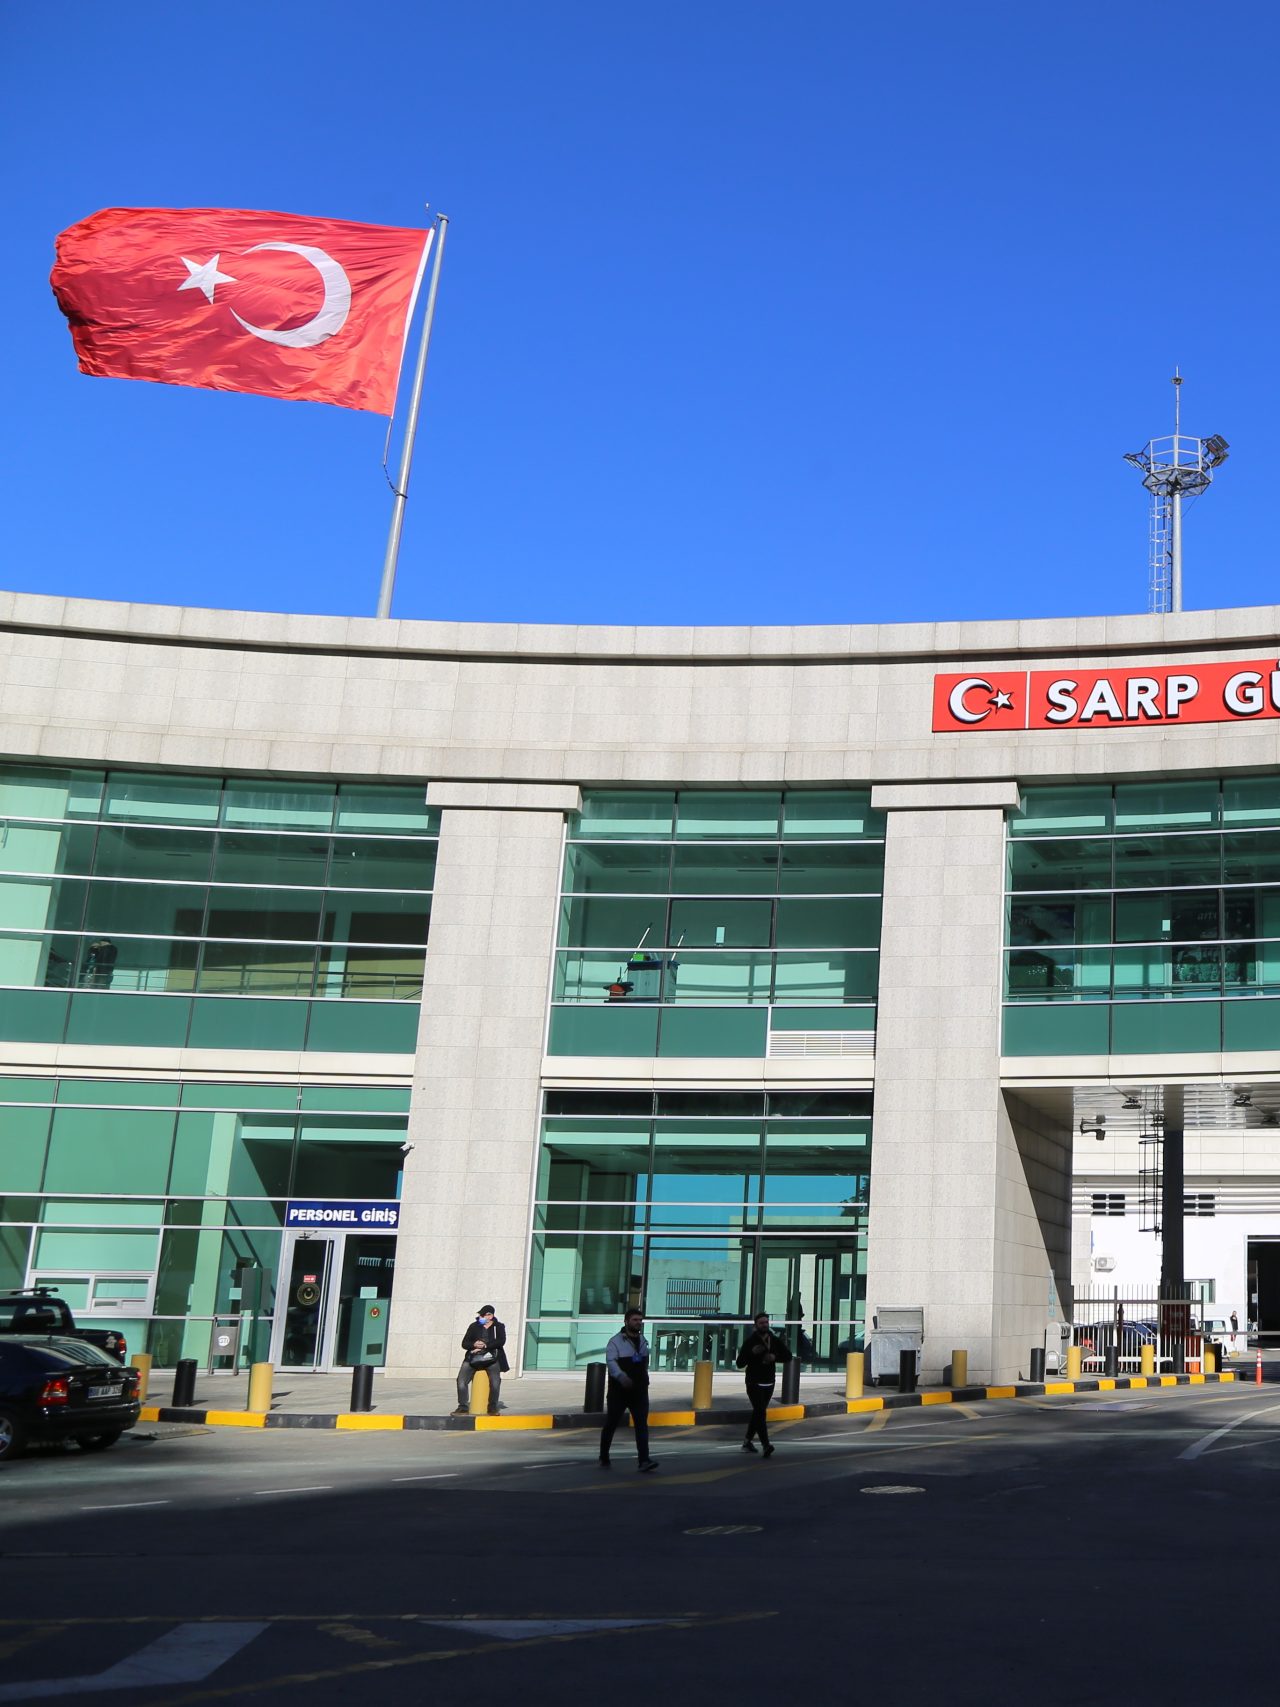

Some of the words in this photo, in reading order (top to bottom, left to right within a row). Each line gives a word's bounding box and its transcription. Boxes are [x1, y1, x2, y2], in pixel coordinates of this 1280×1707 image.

[1045, 673, 1200, 724] SARP
[289, 1208, 358, 1222] PERSONEL
[361, 1208, 397, 1225] GİRİŞ
